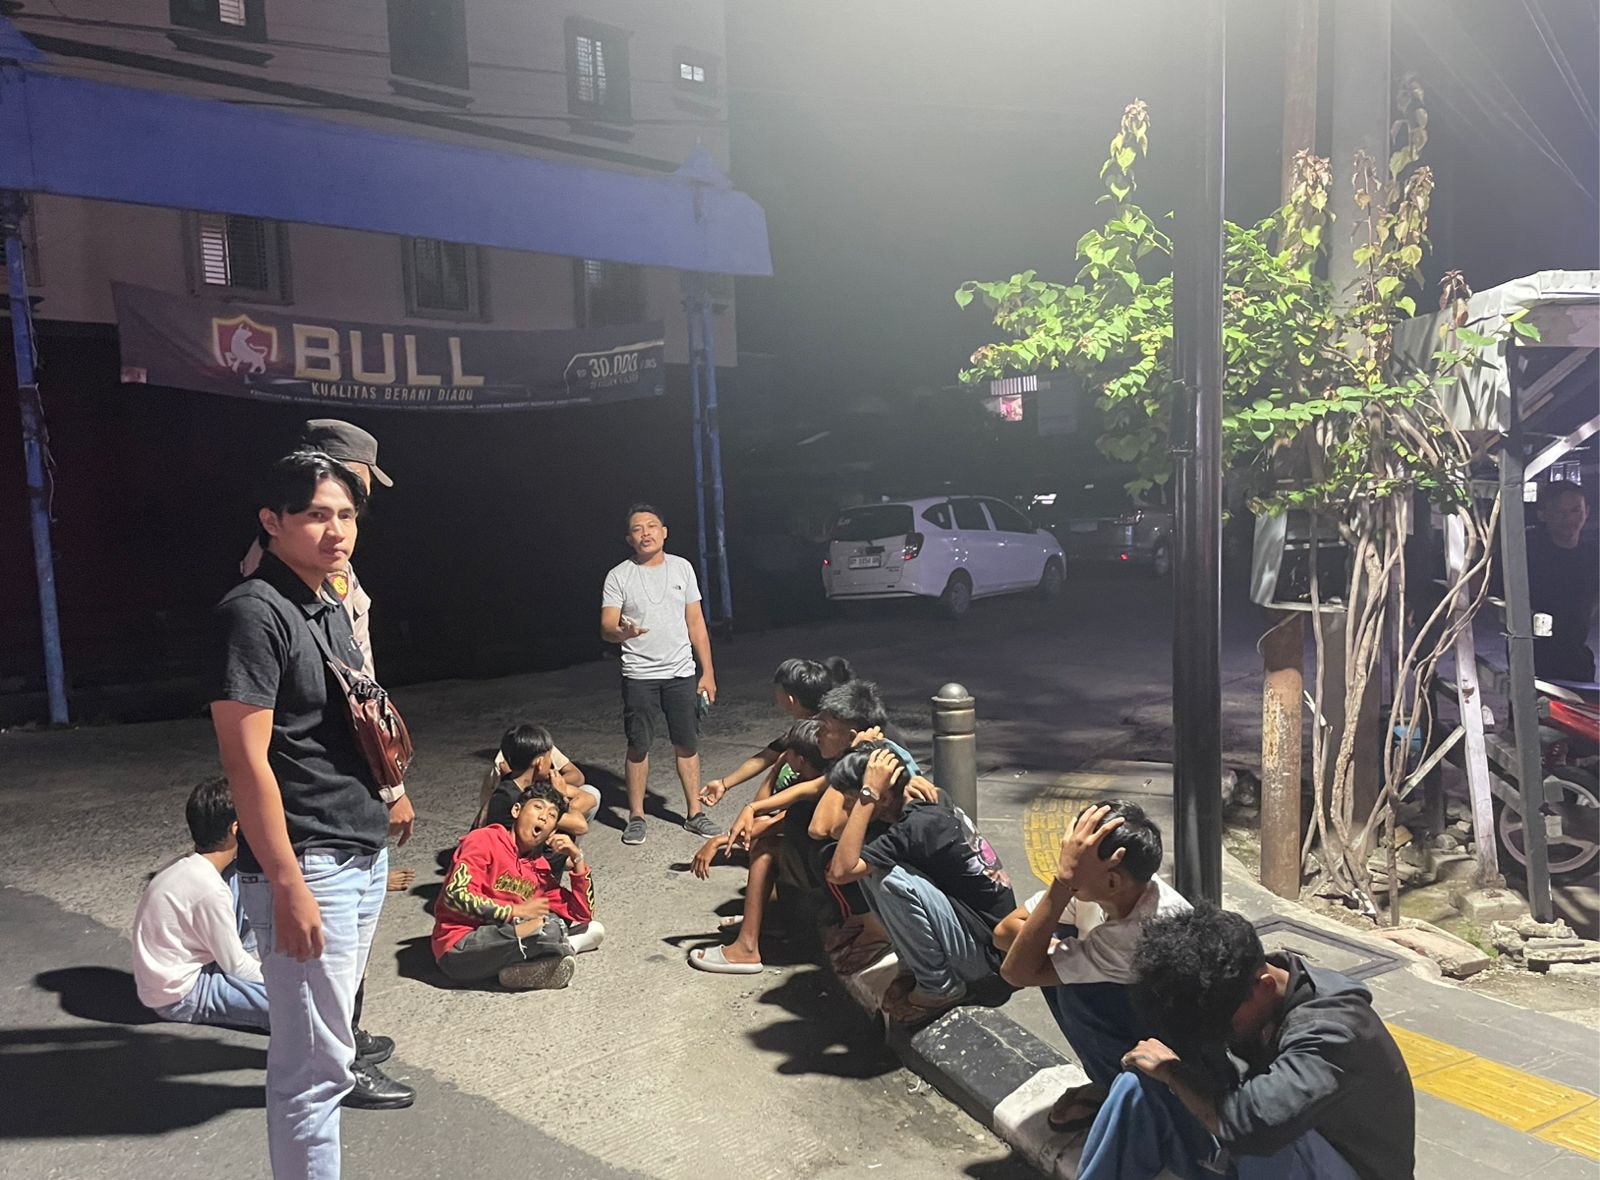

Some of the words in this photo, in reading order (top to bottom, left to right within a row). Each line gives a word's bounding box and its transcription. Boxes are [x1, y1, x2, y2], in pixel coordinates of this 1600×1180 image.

[292, 323, 485, 386] BULL
[589, 352, 638, 378] 30.000
[311, 382, 377, 400] KUALITAS
[384, 387, 431, 401] BERANI
